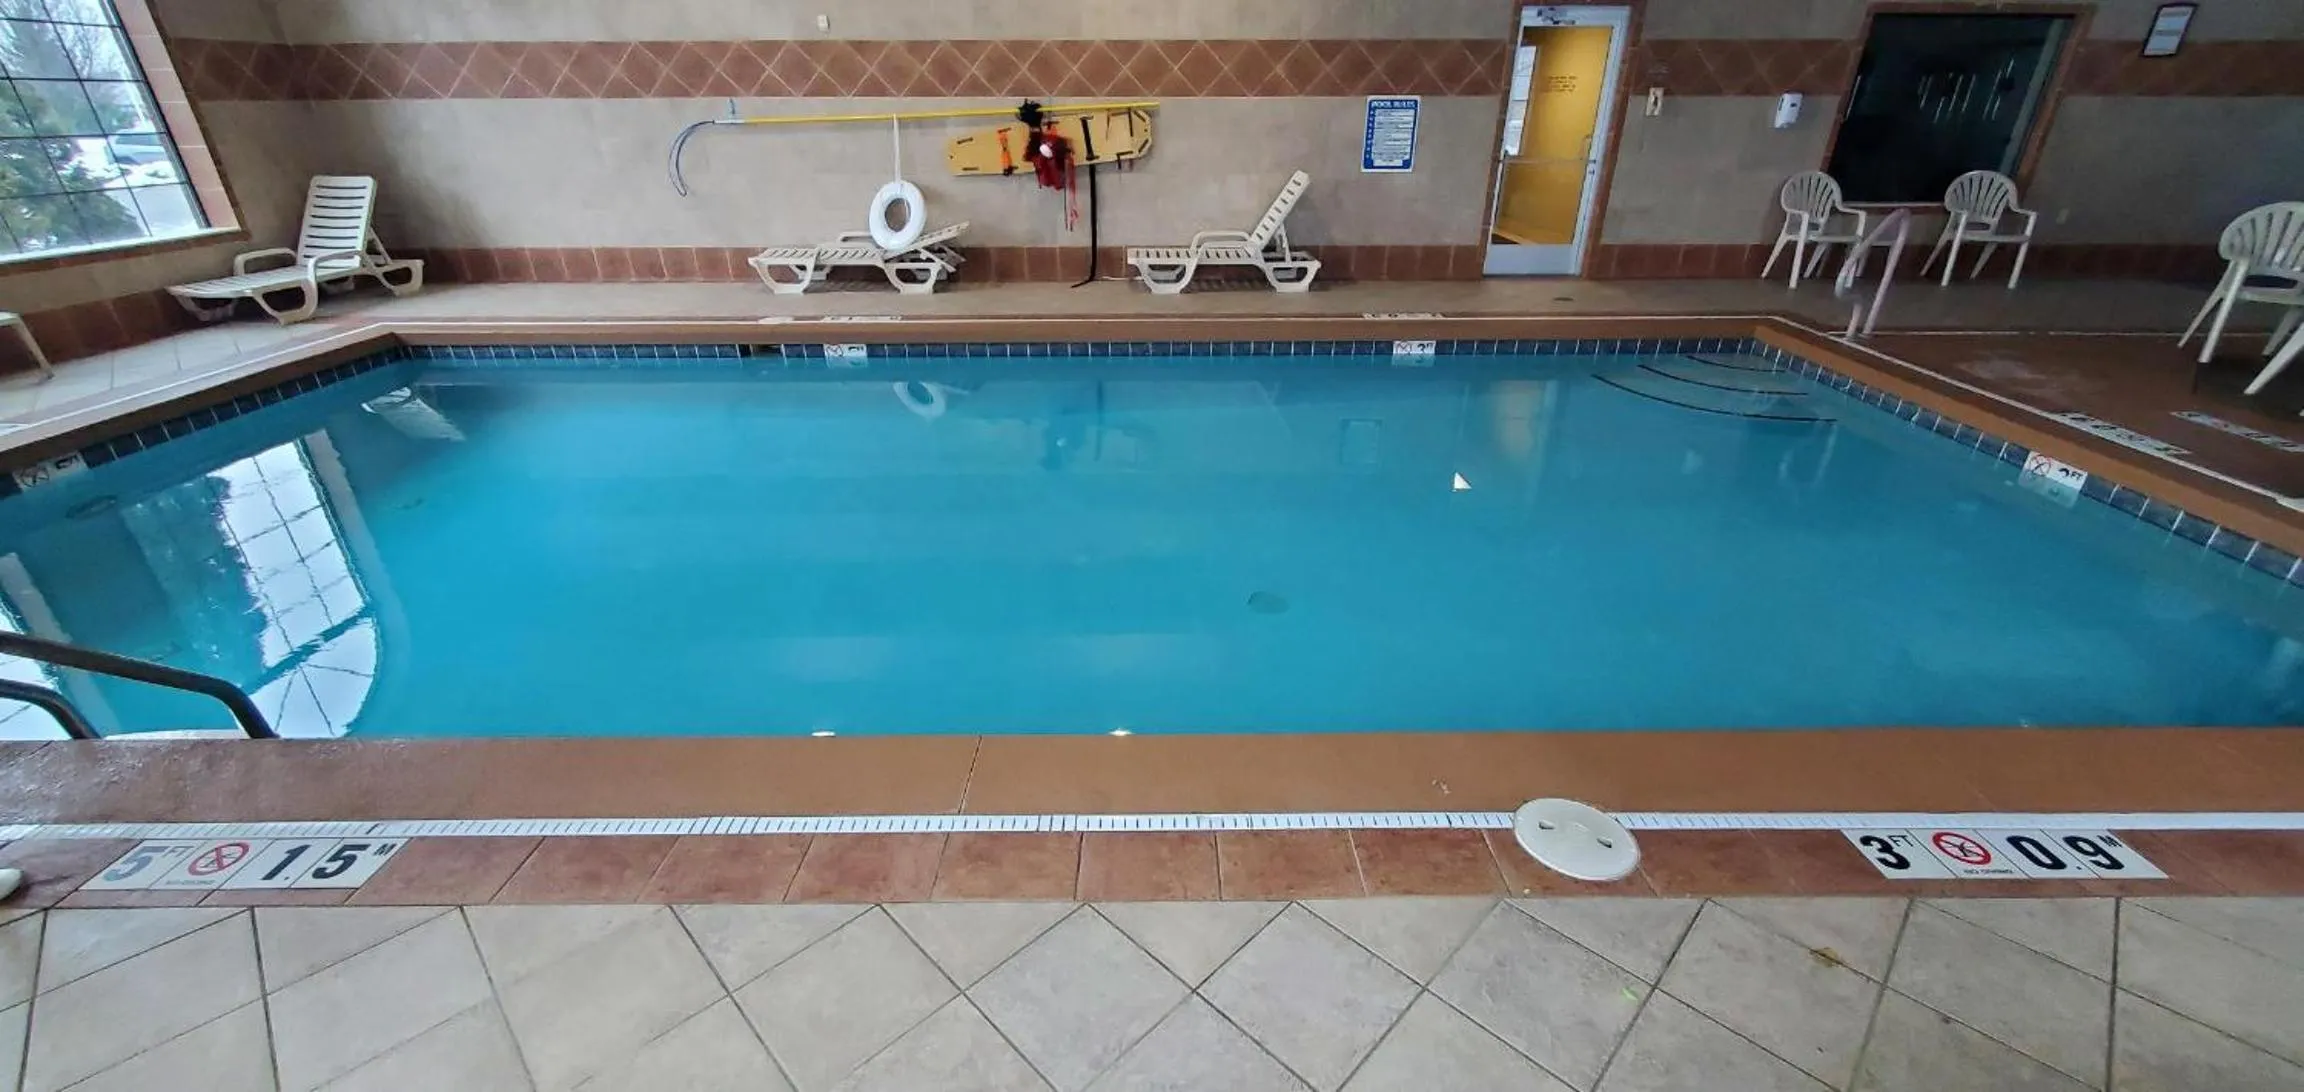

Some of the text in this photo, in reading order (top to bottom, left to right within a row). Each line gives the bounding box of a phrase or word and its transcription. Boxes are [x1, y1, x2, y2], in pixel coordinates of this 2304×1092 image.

[102, 846, 170, 882] 5
[161, 846, 195, 858] FT
[373, 843, 398, 856] M
[1859, 835, 1911, 870] 3
[1887, 834, 1914, 847] FT
[2097, 834, 2123, 848] M
